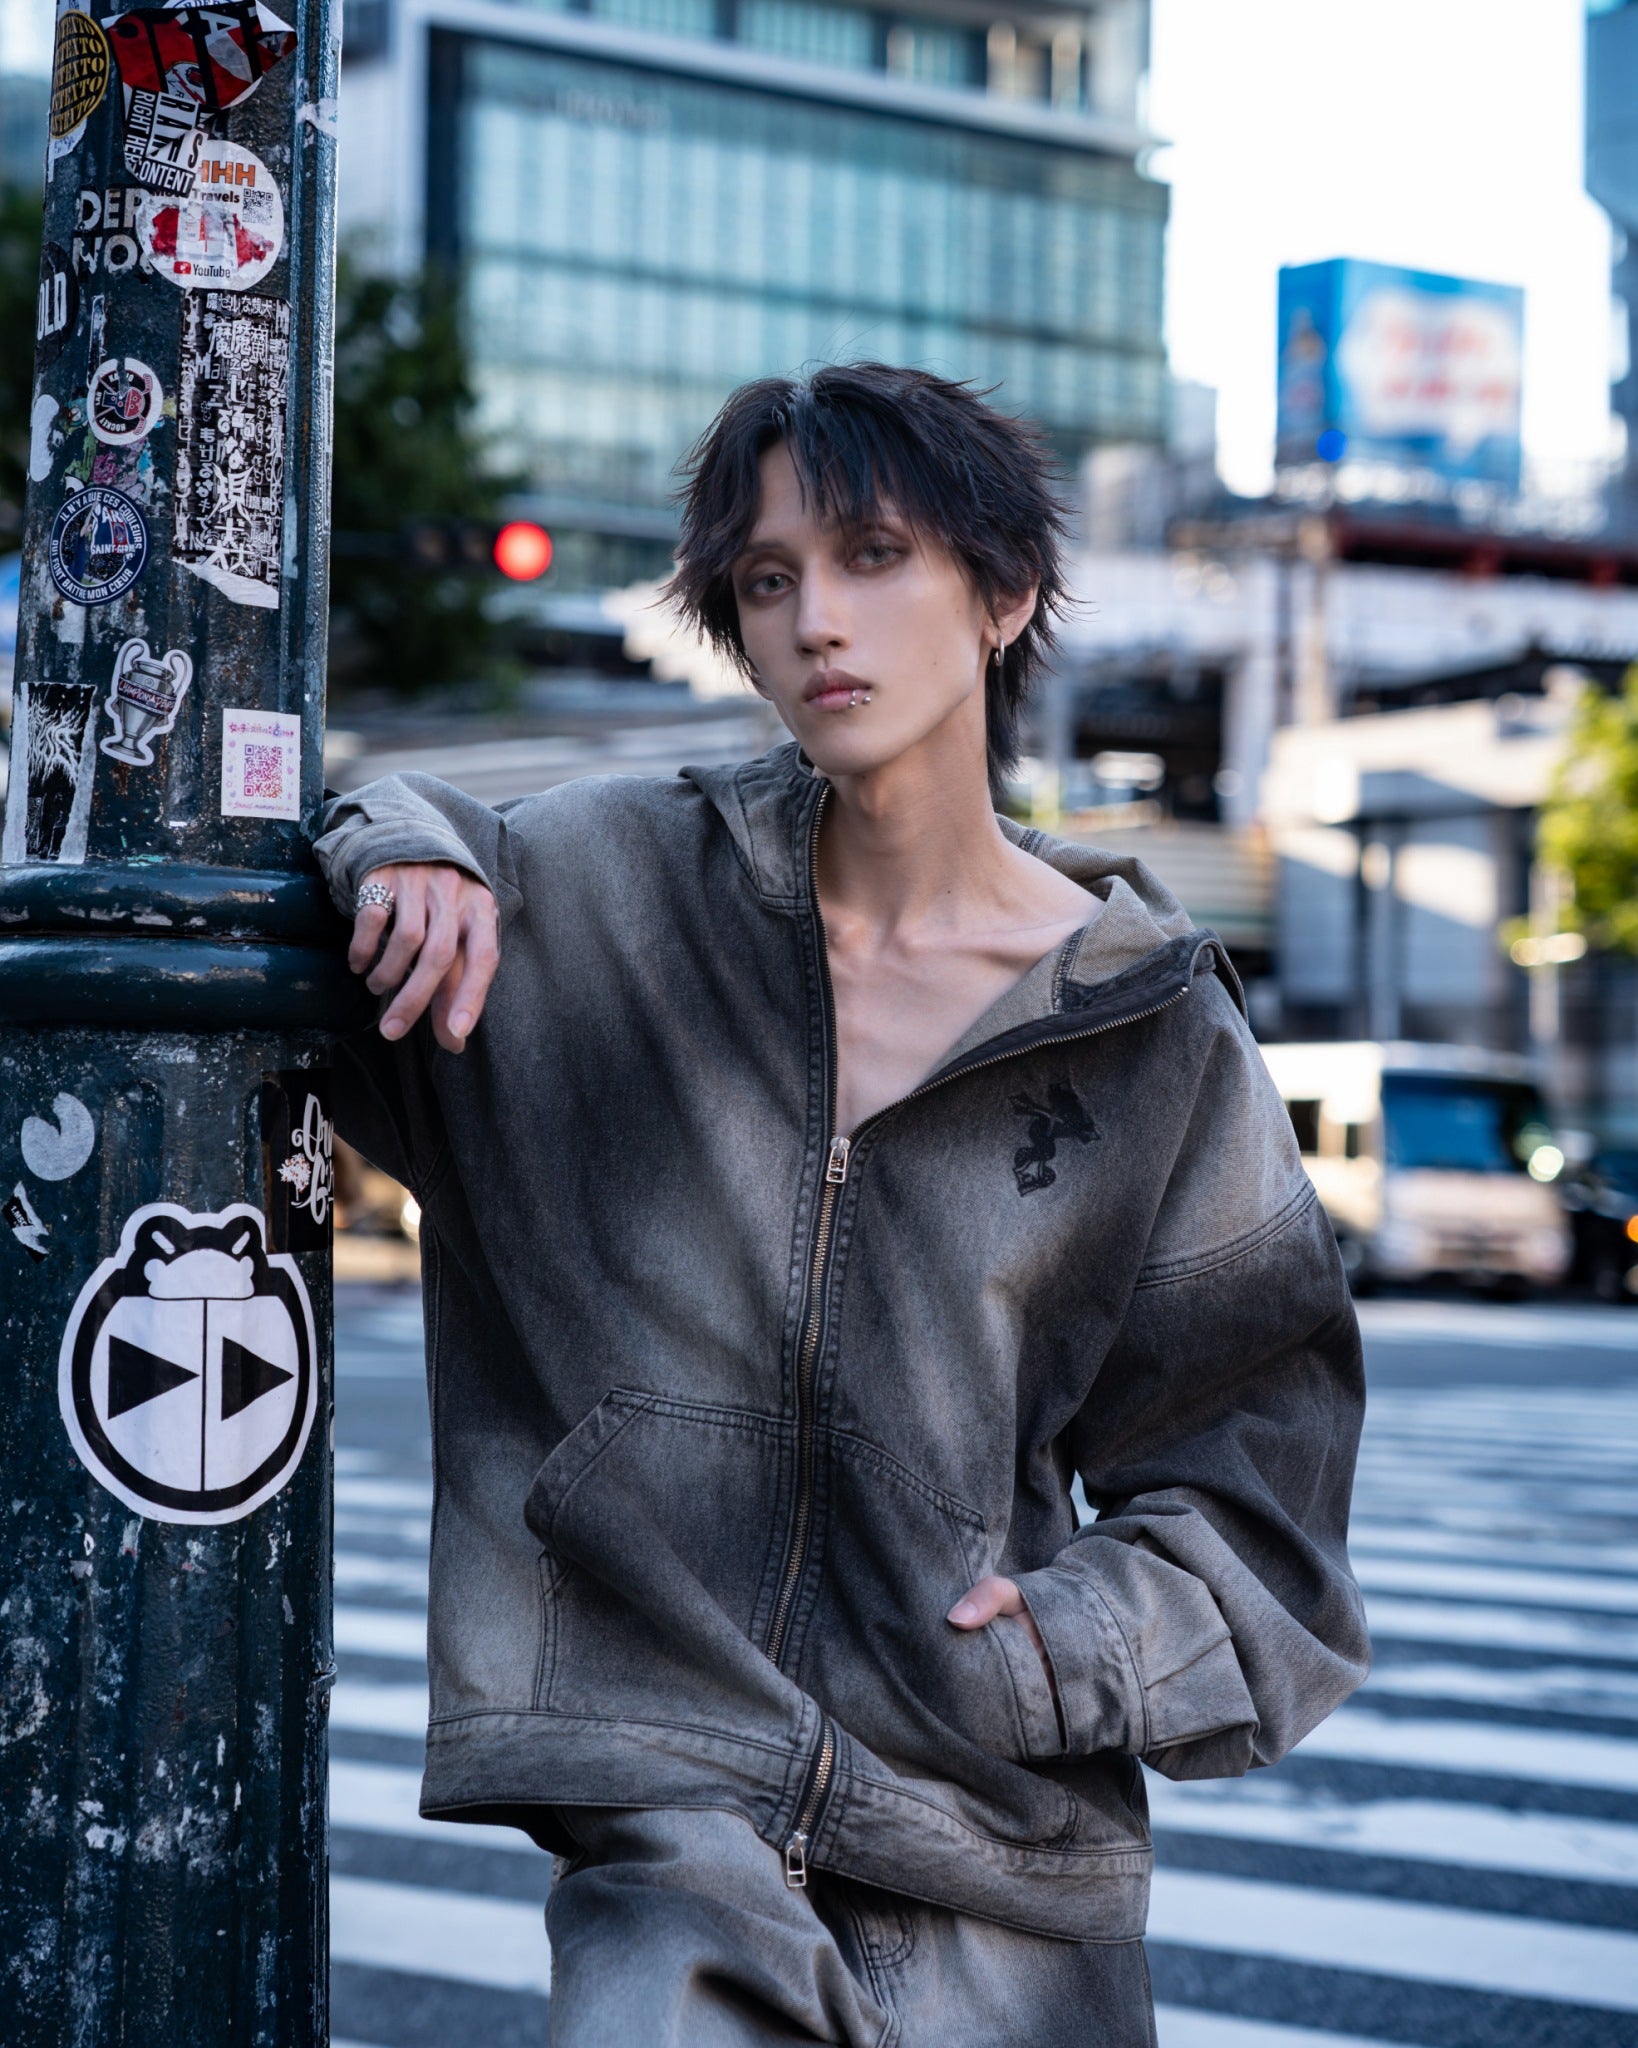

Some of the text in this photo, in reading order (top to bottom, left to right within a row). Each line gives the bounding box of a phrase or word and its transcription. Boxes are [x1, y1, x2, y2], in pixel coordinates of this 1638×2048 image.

[129, 90, 156, 134] RIGHT
[192, 188, 240, 203] Travels
[193, 264, 231, 279] YouTube
[99, 417, 126, 432] HOCKEY
[60, 511, 70, 522] IL
[87, 491, 102, 503] QUE
[103, 493, 120, 509] CES
[118, 503, 143, 550] COULEURS
[51, 539, 59, 557] QUI
[52, 557, 66, 581] FONT
[61, 578, 87, 599] BATTRE
[87, 586, 108, 600] MON
